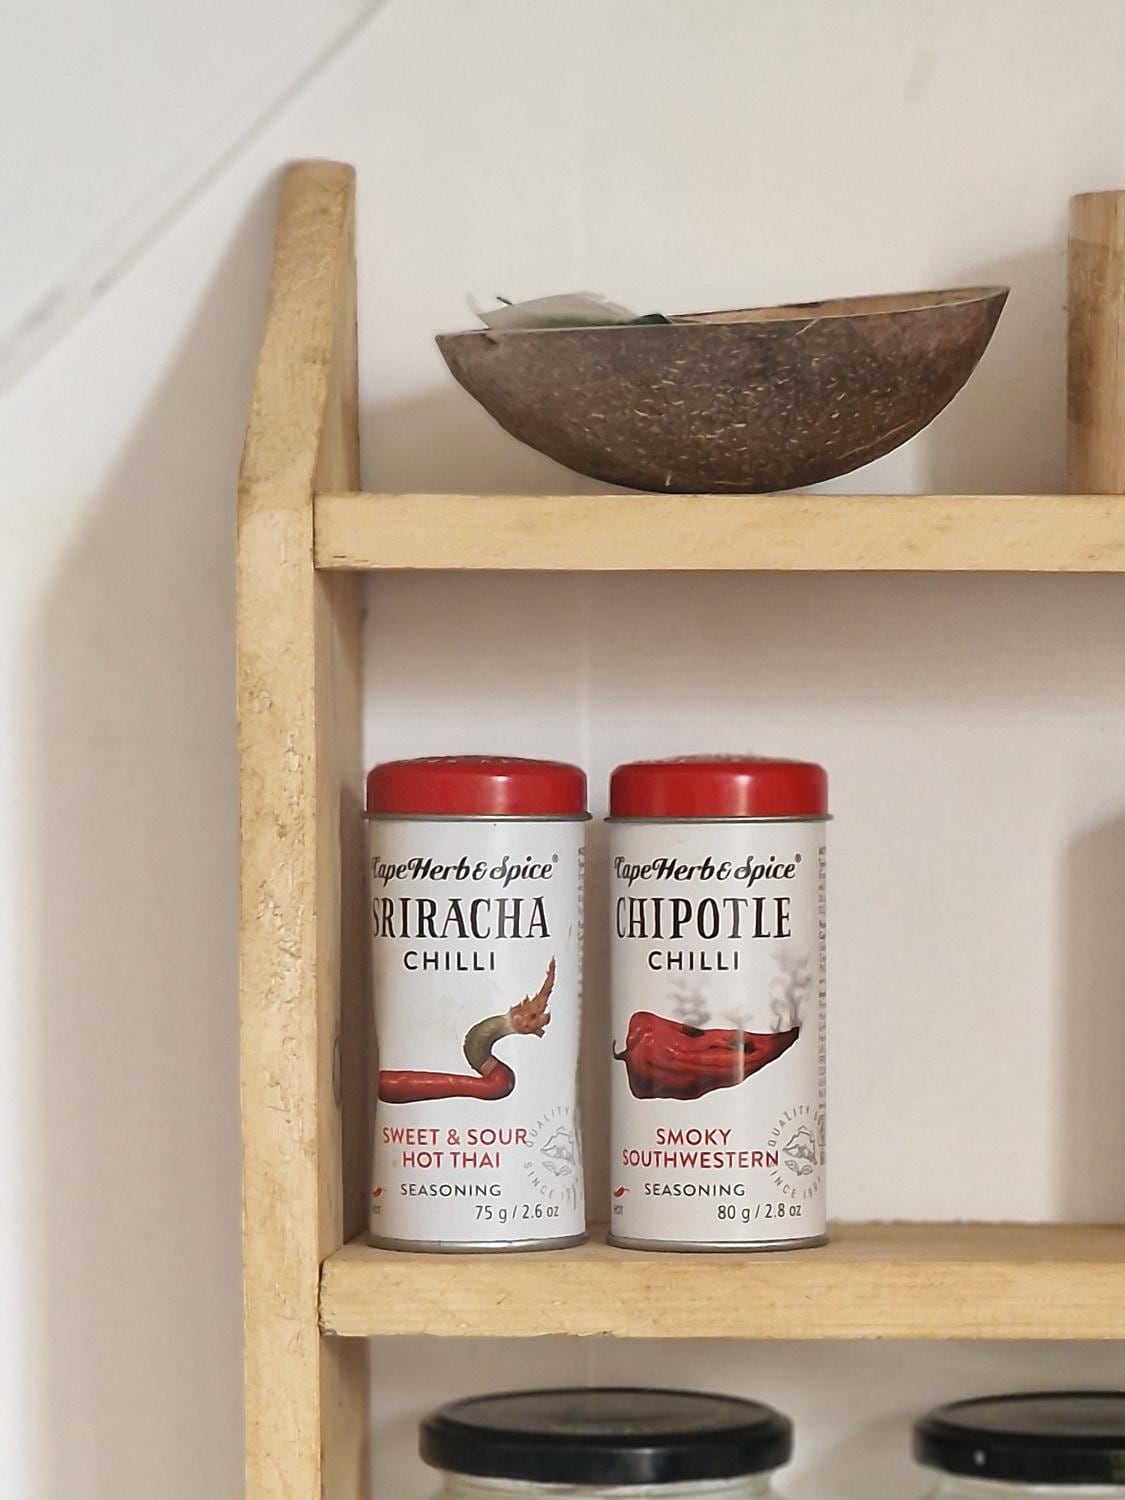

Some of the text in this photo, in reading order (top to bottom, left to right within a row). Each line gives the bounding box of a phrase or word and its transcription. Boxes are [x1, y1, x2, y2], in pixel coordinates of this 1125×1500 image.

[373, 896, 551, 939] SRIRACHA
[616, 896, 792, 939] CHIPOTLE
[404, 951, 495, 971] CHILLI
[649, 951, 739, 971] CHILLI
[383, 1128, 528, 1145] SWEET & SOUR
[656, 1129, 732, 1146] SMOKY
[402, 1152, 500, 1169] HOT THAI
[623, 1149, 779, 1169] SOUTHWESTERN
[400, 1184, 502, 1197] SEASONING
[644, 1183, 745, 1197] SEASONING
[475, 1205, 493, 1221] 75
[498, 1207, 507, 1224] g
[521, 1203, 543, 1219] 2.6
[546, 1205, 560, 1218] oz
[717, 1205, 736, 1220] 80
[741, 1207, 750, 1224] g
[764, 1203, 786, 1219] 2.8
[789, 1204, 802, 1217] oz
